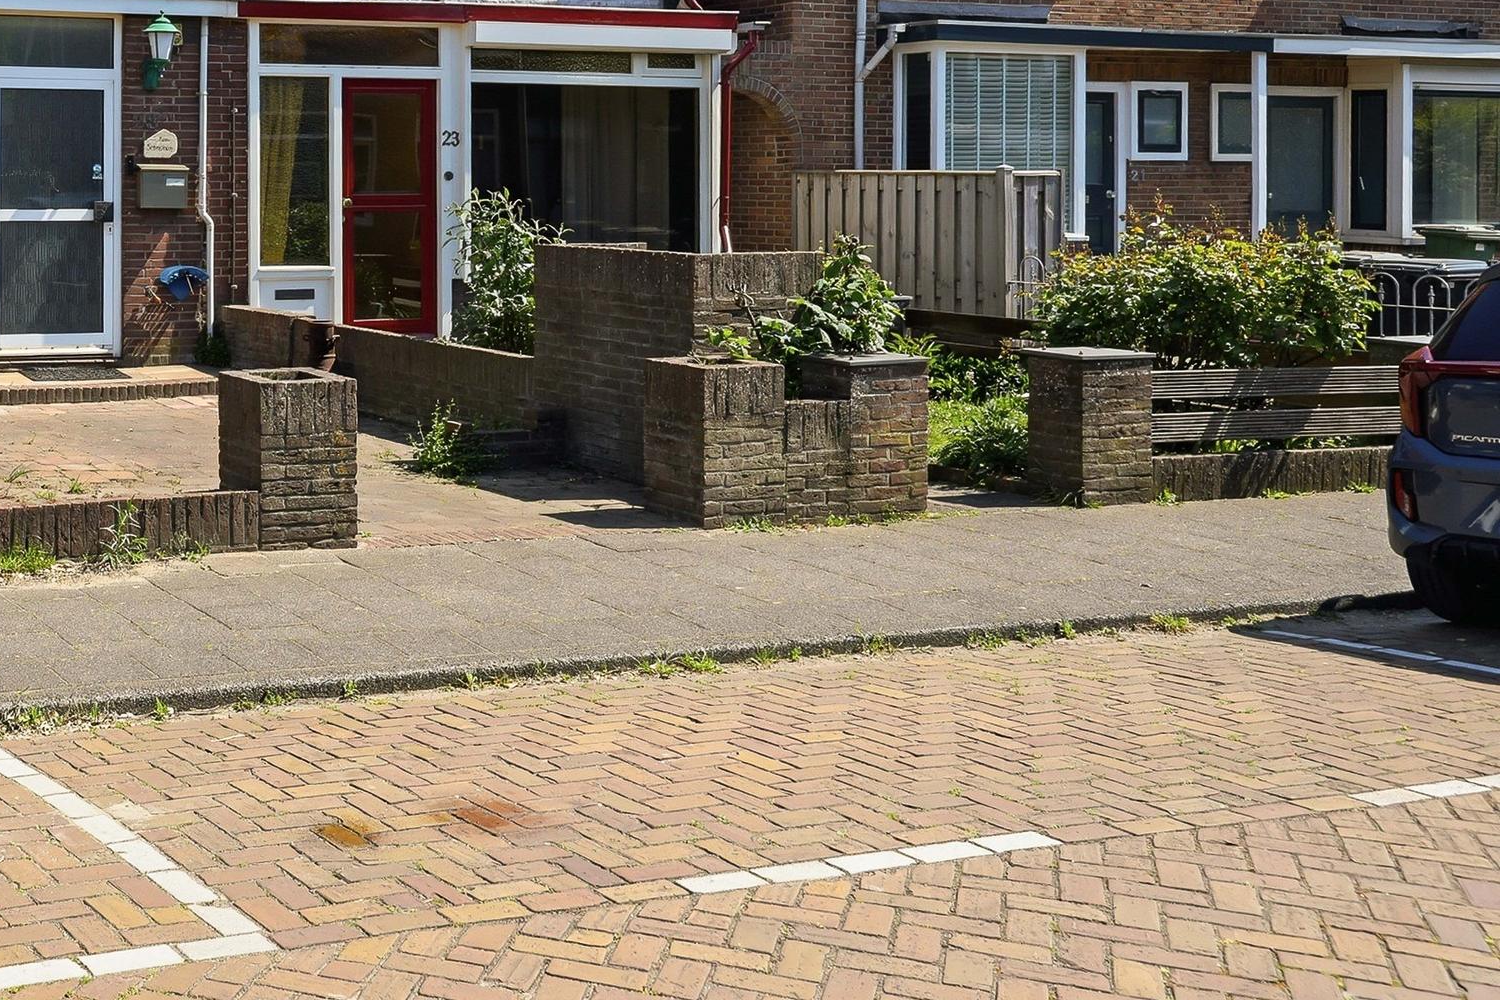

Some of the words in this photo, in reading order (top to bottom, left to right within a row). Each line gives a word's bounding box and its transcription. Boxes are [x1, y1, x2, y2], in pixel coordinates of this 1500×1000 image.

[441, 129, 460, 147] 23
[1131, 169, 1145, 181] 21
[1451, 434, 1500, 444] PICANT
